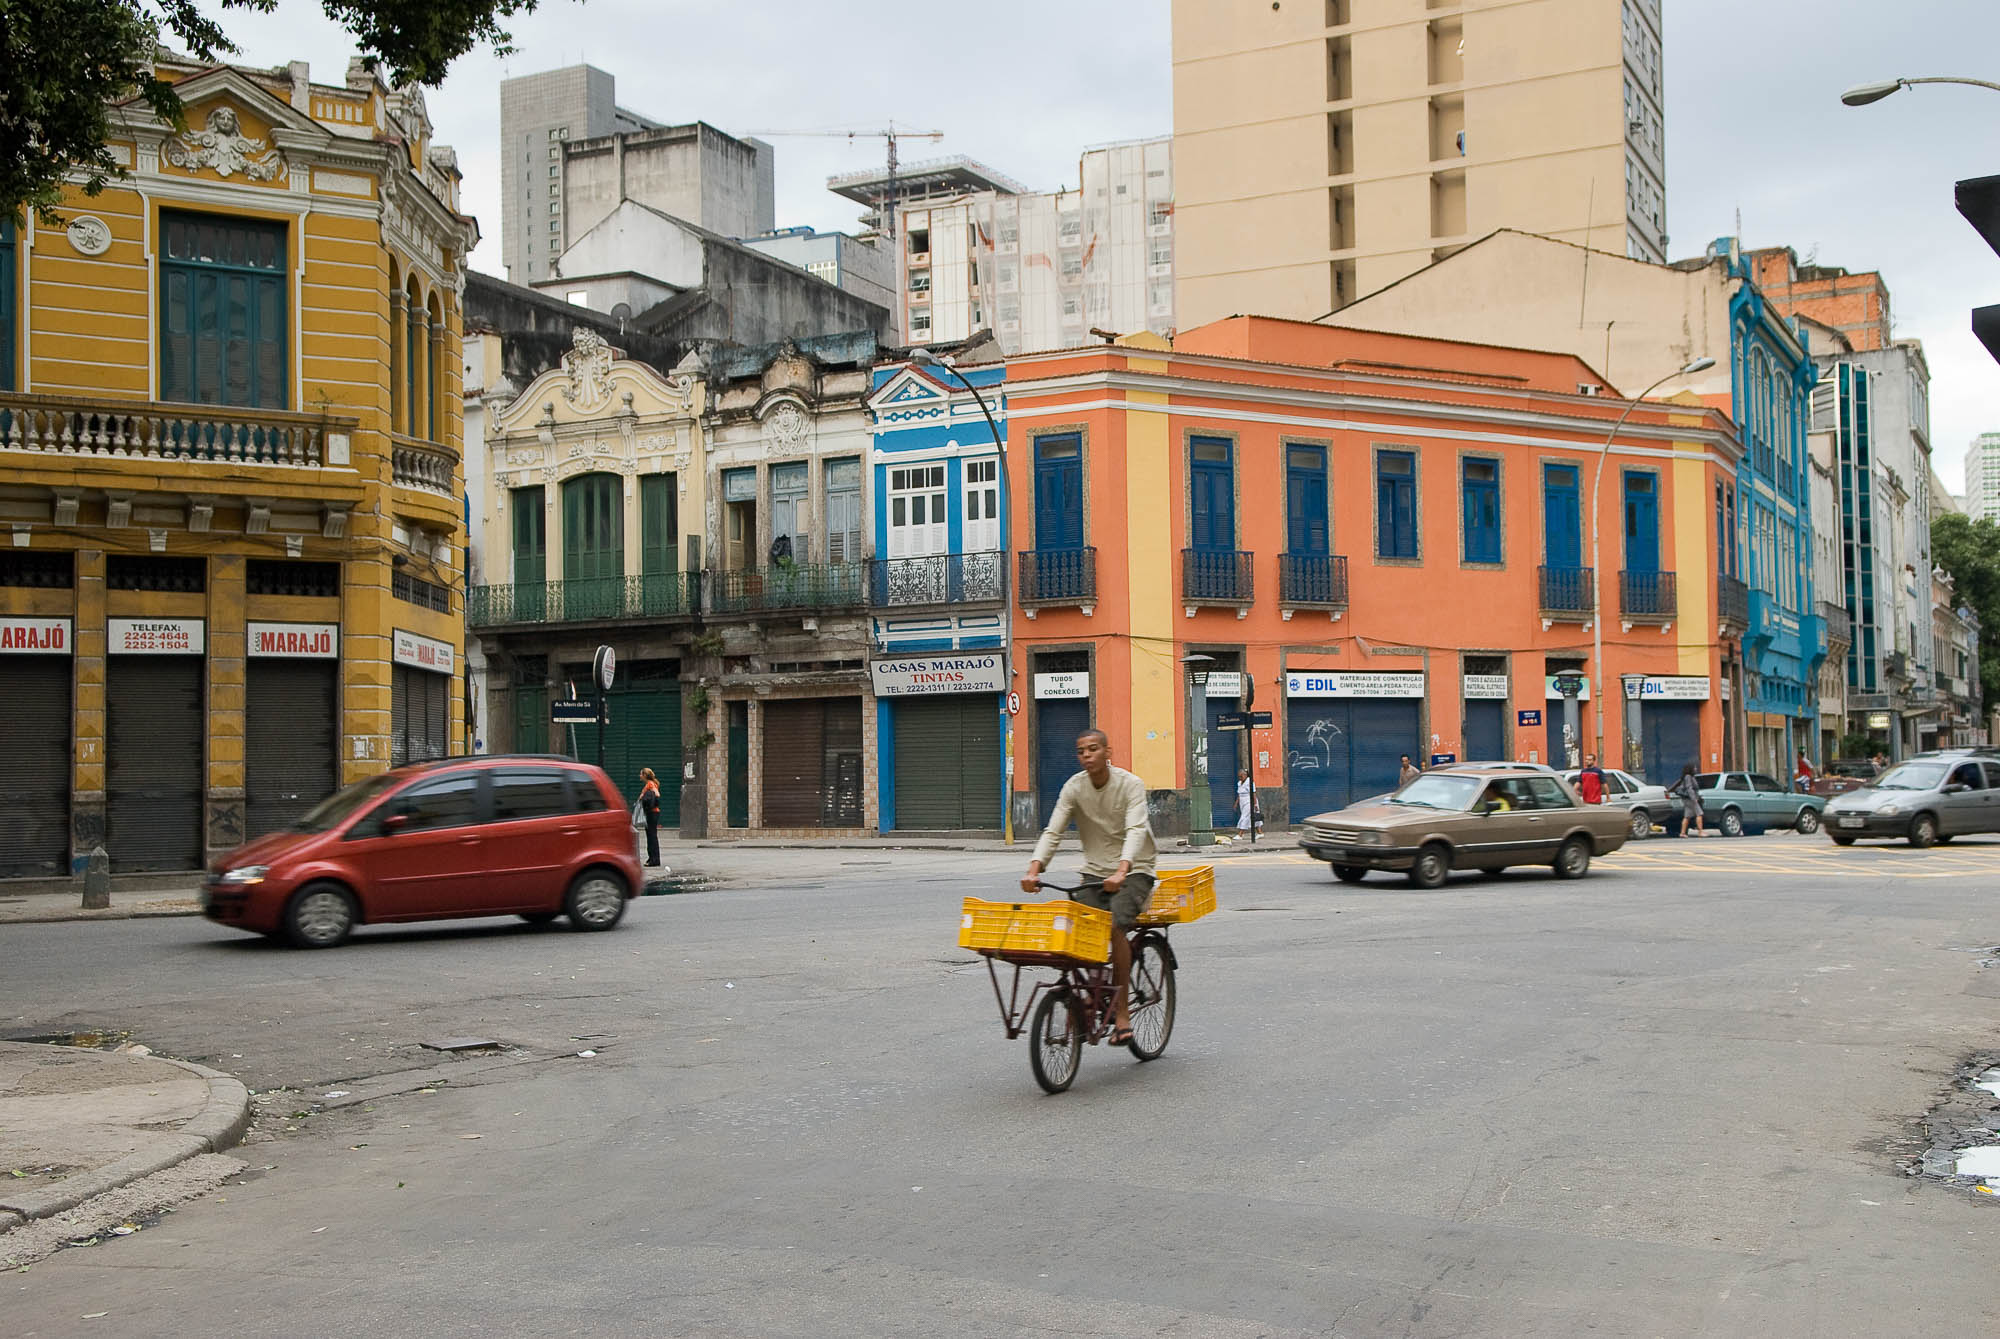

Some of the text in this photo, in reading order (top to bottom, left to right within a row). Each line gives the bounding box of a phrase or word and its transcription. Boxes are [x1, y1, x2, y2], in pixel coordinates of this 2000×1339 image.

[131, 624, 182, 632] TELEFAX:
[124, 632, 189, 640] 2242-4648
[261, 629, 331, 653] MARAJÓ
[124, 641, 189, 649] 2252-1504
[878, 656, 995, 674] CASAS MARAJÓ
[911, 672, 964, 684] TINTAS
[886, 686, 904, 694] TEL:
[906, 684, 945, 693] 2222-1311
[953, 682, 994, 691] 2232-2774
[1306, 679, 1337, 691] EDIL
[1640, 682, 1664, 694] EDIL
